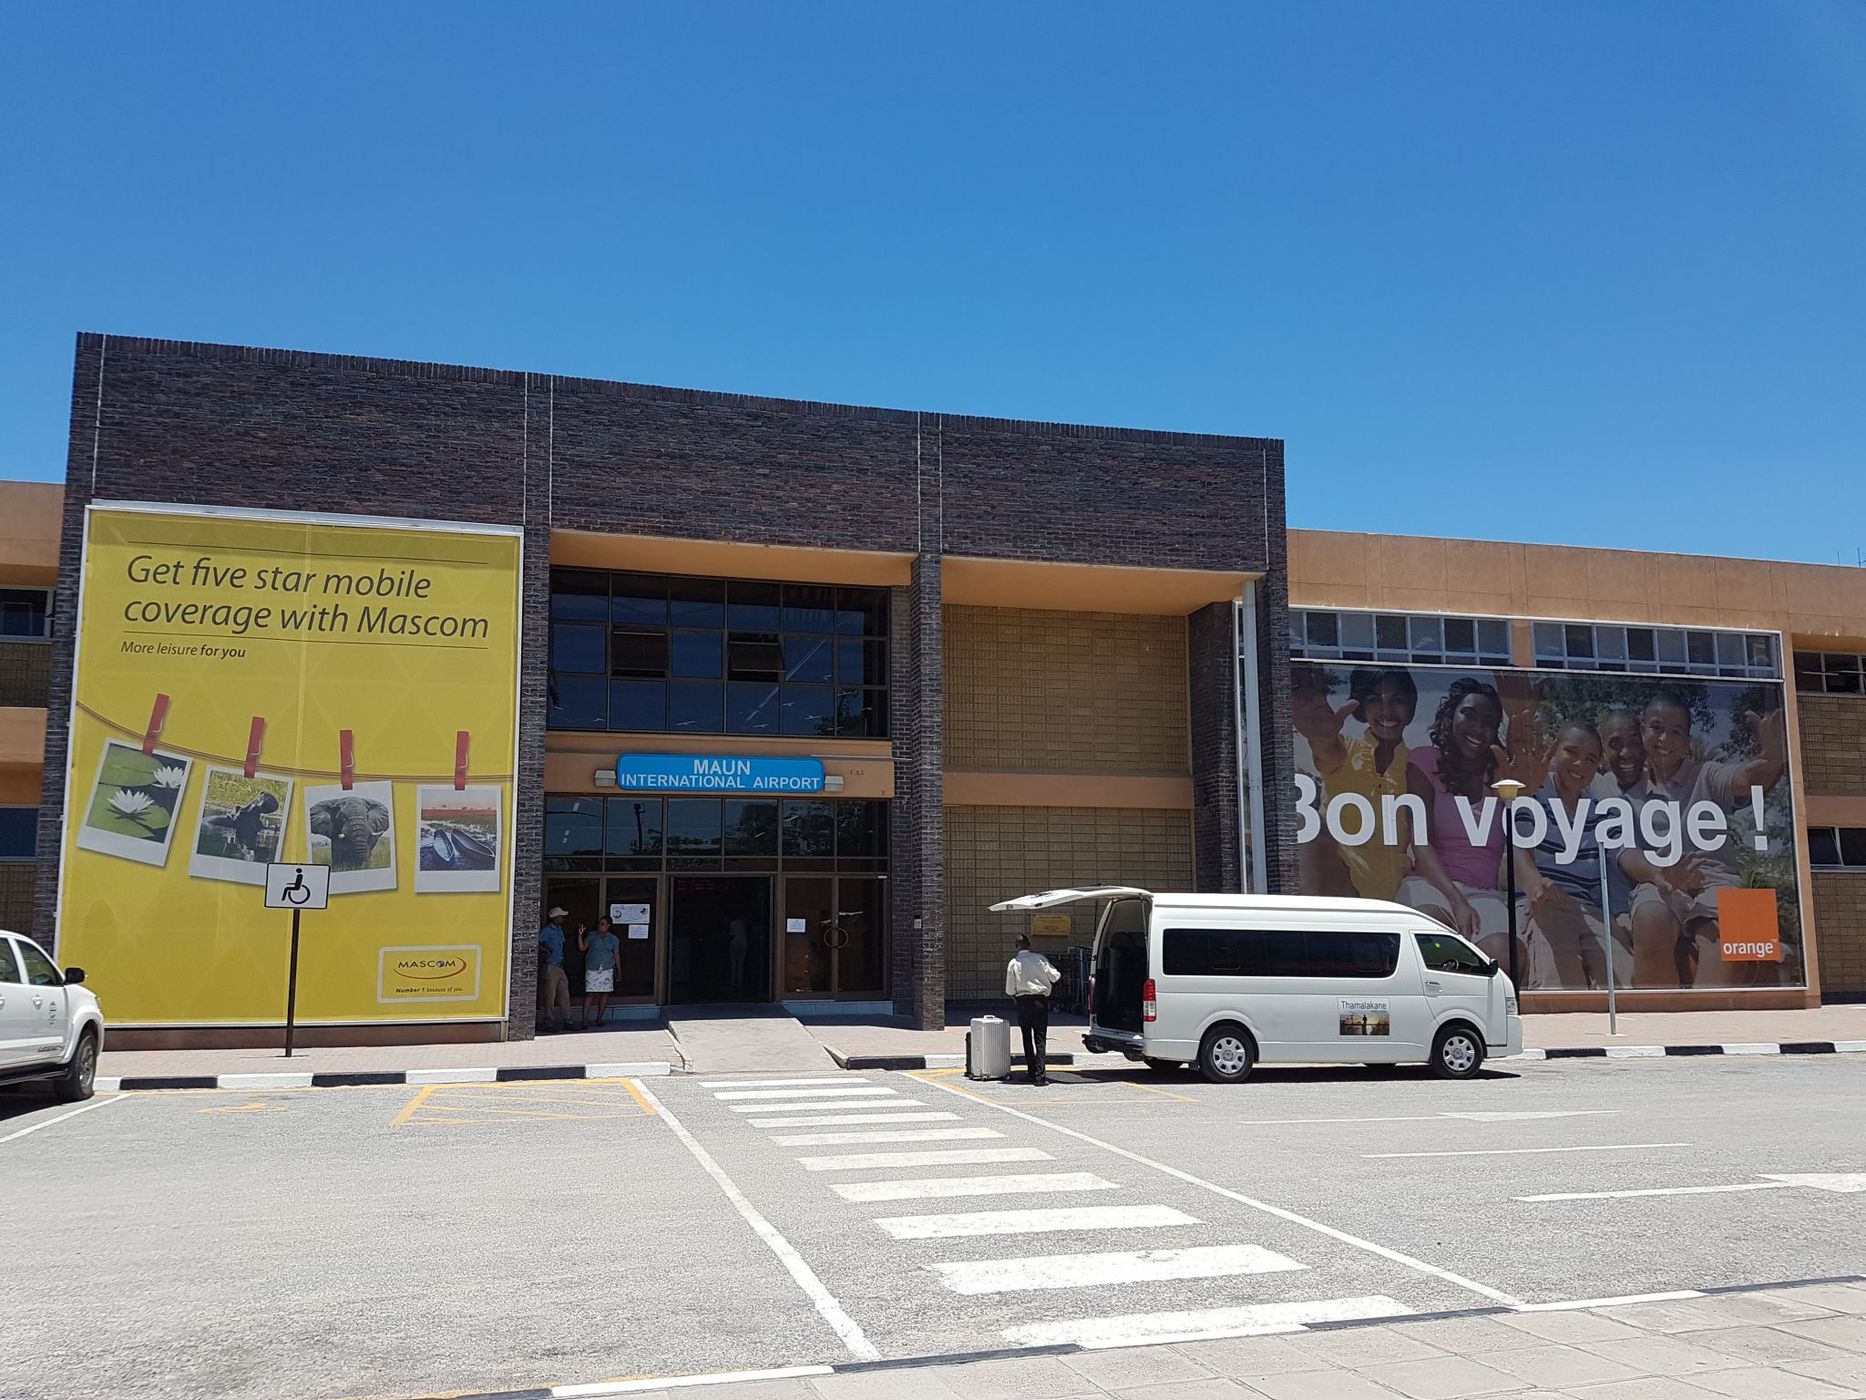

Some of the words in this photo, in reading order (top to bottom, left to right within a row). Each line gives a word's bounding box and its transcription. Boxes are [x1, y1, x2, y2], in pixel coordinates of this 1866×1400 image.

[127, 555, 184, 586] Get
[191, 557, 247, 589] five
[254, 566, 317, 593] star
[322, 568, 431, 599] mobile
[124, 600, 271, 635] coverage
[280, 603, 349, 633] with
[356, 606, 489, 638] Mascom
[120, 641, 154, 654] More
[156, 642, 202, 657] leisure
[200, 643, 219, 657] for
[221, 648, 246, 660] you
[693, 759, 751, 775] MAUN
[621, 773, 746, 788] INTERNATIONAL
[753, 776, 820, 789] AIRPORT
[1294, 773, 1429, 847] Bon
[1453, 792, 1728, 868] voyage
[1723, 942, 1774, 958] orange
[397, 960, 456, 968] MASCOM
[1341, 1000, 1387, 1010] Thamalakane
